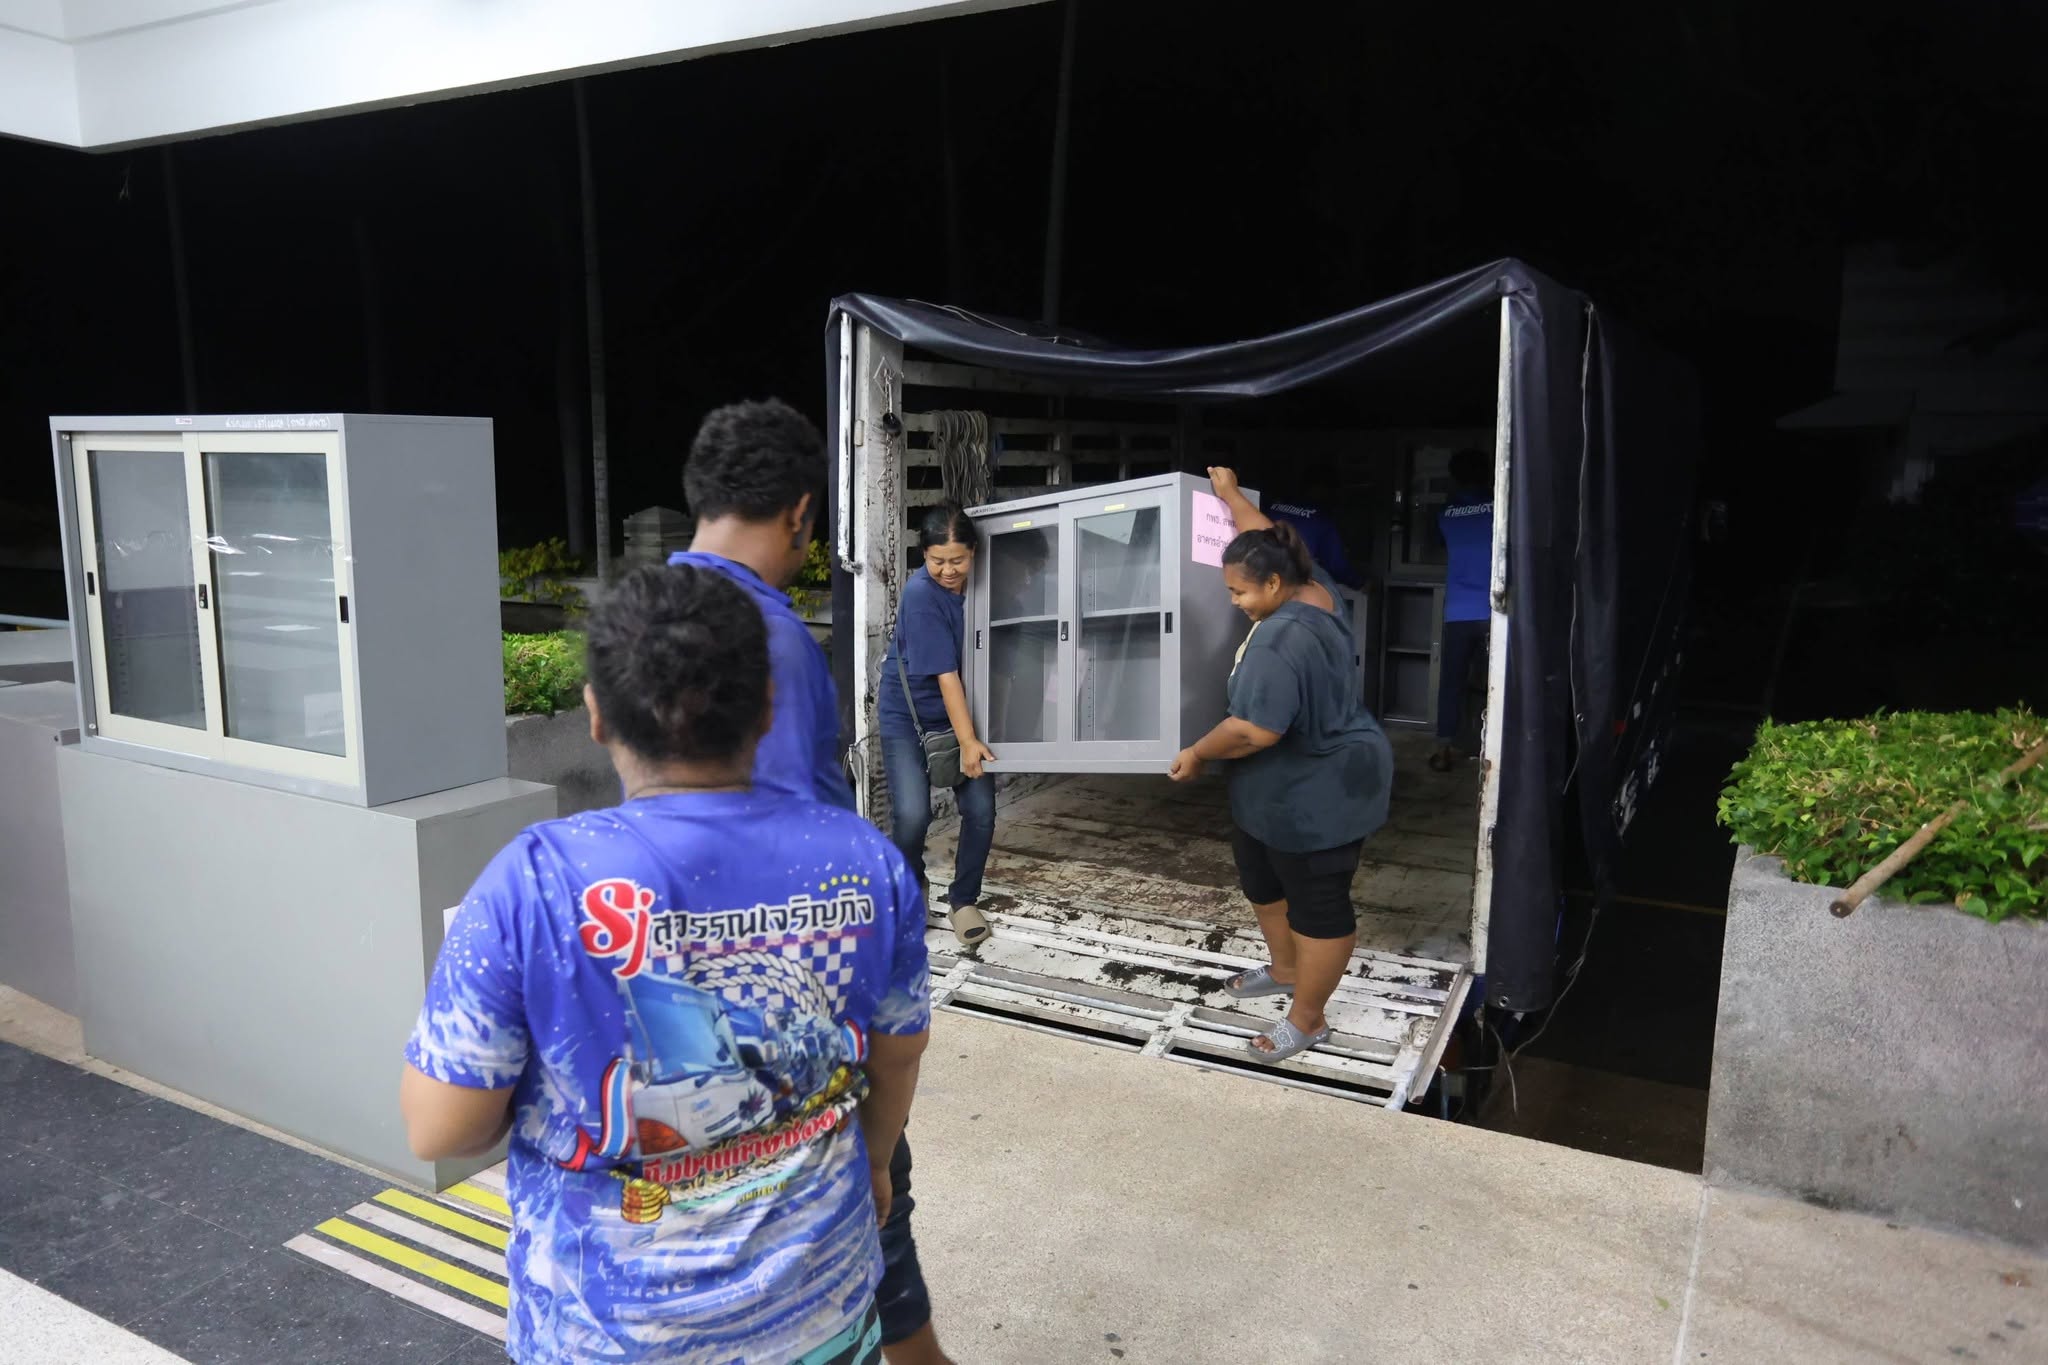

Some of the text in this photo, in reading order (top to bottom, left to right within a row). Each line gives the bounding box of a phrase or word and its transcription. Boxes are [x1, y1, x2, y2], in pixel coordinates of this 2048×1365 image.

[654, 890, 872, 951] สุวรรณเจริญกิจ
